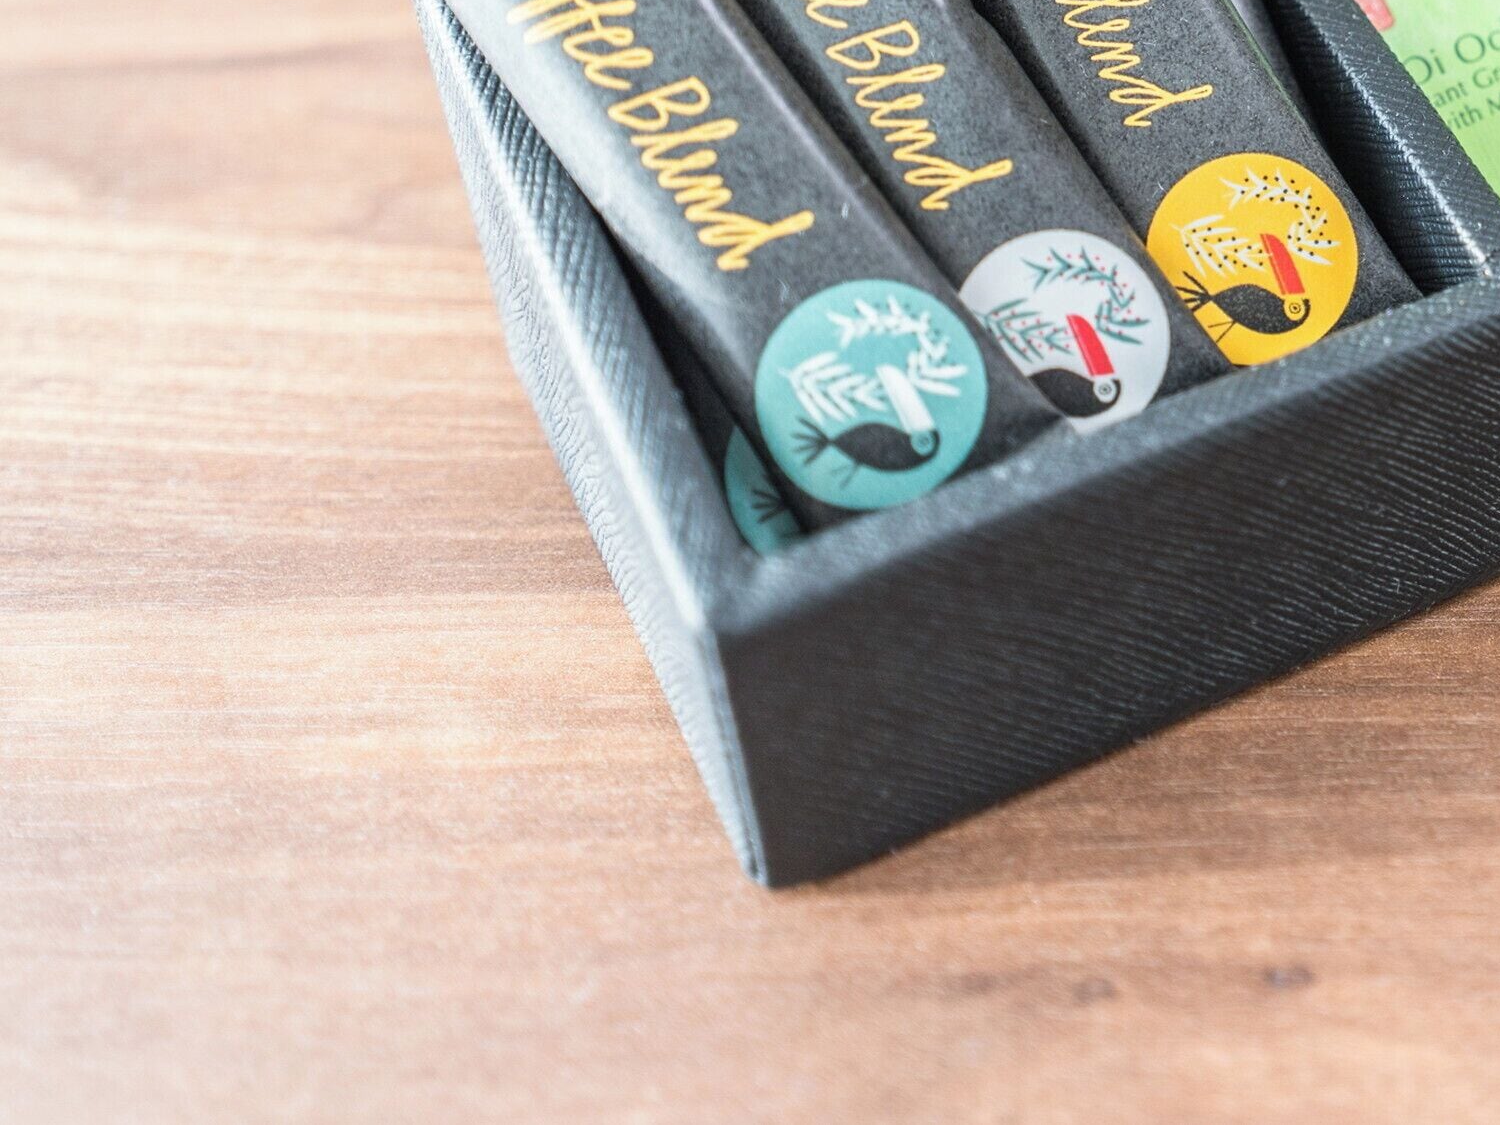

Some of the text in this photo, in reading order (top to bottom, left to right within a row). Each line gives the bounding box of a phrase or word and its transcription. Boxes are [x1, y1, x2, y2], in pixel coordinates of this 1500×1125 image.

[607, 76, 815, 271] Blend
[826, 21, 1014, 211] Blend
[1450, 104, 1483, 129] ith
